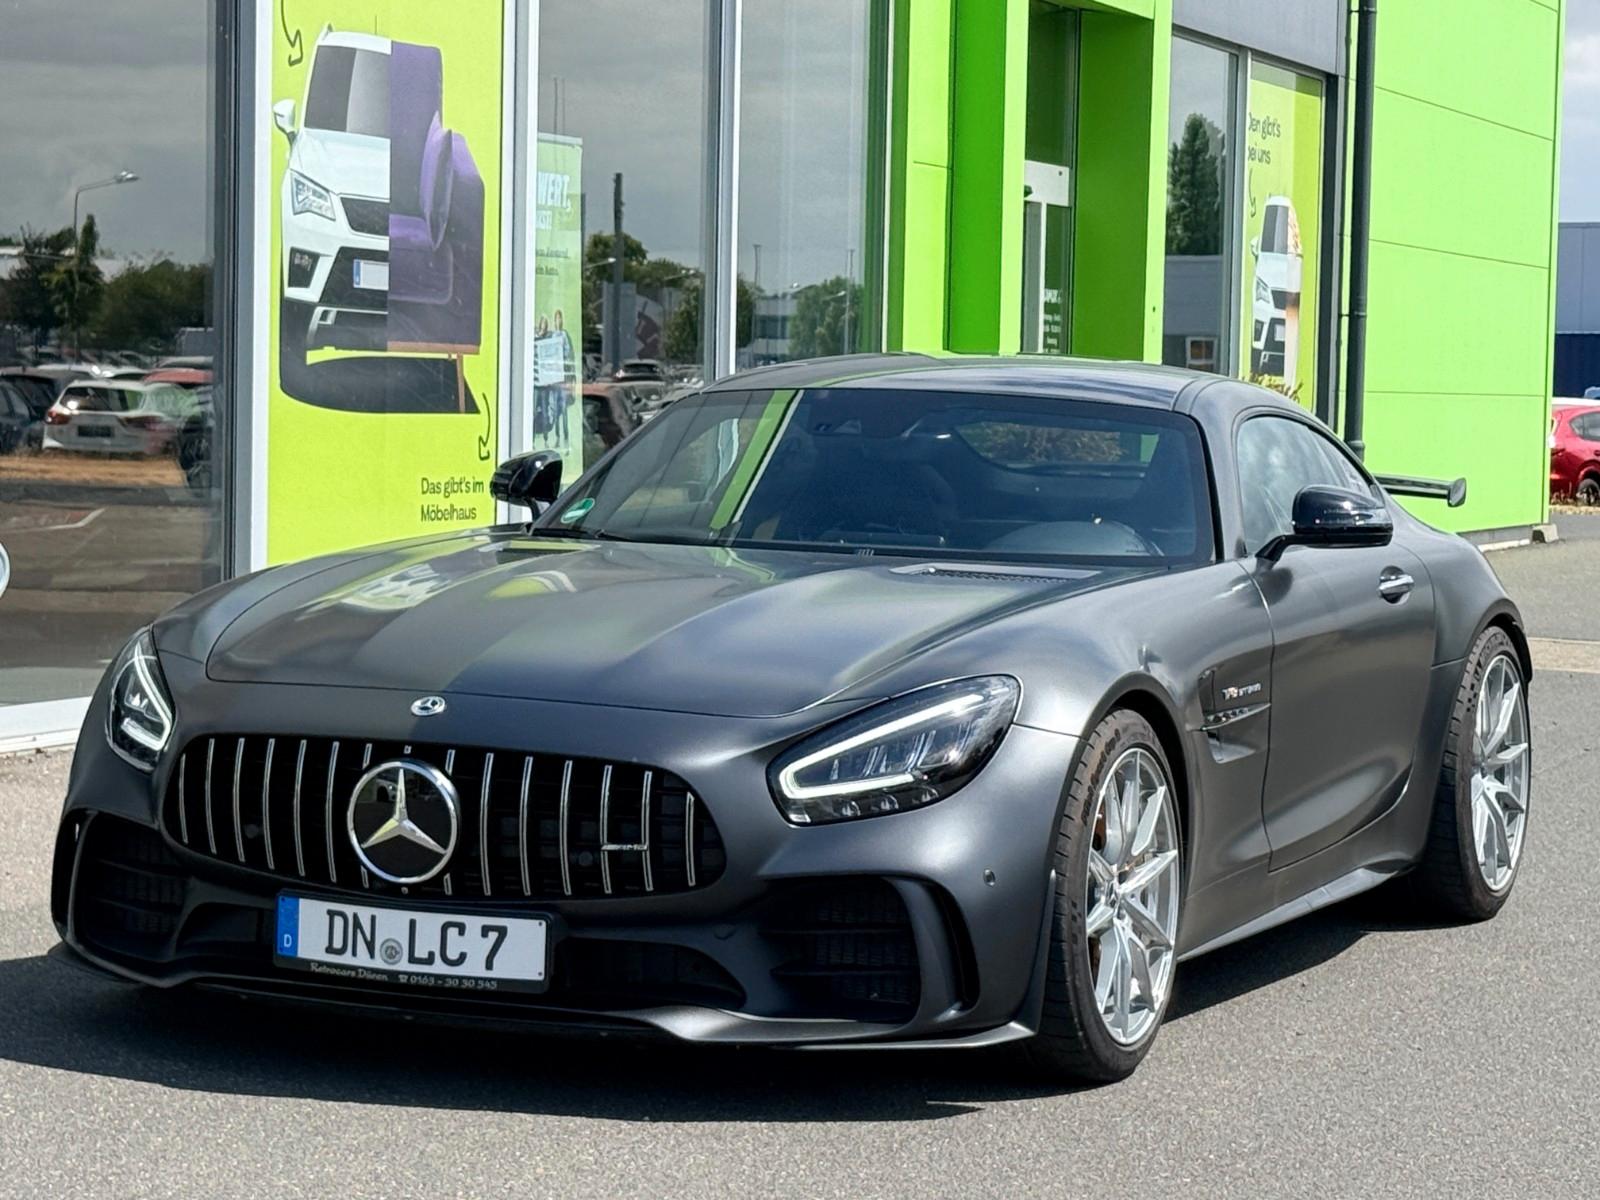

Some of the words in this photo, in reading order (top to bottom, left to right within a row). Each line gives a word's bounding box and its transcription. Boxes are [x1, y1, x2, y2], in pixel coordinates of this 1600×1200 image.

[421, 477, 442, 495] Das
[443, 476, 471, 499] gibt's
[472, 476, 485, 494] im
[421, 503, 477, 522] Möbelhaus
[283, 933, 293, 948] D
[325, 908, 377, 960] DN
[408, 918, 467, 967] LC
[480, 925, 508, 971] 7
